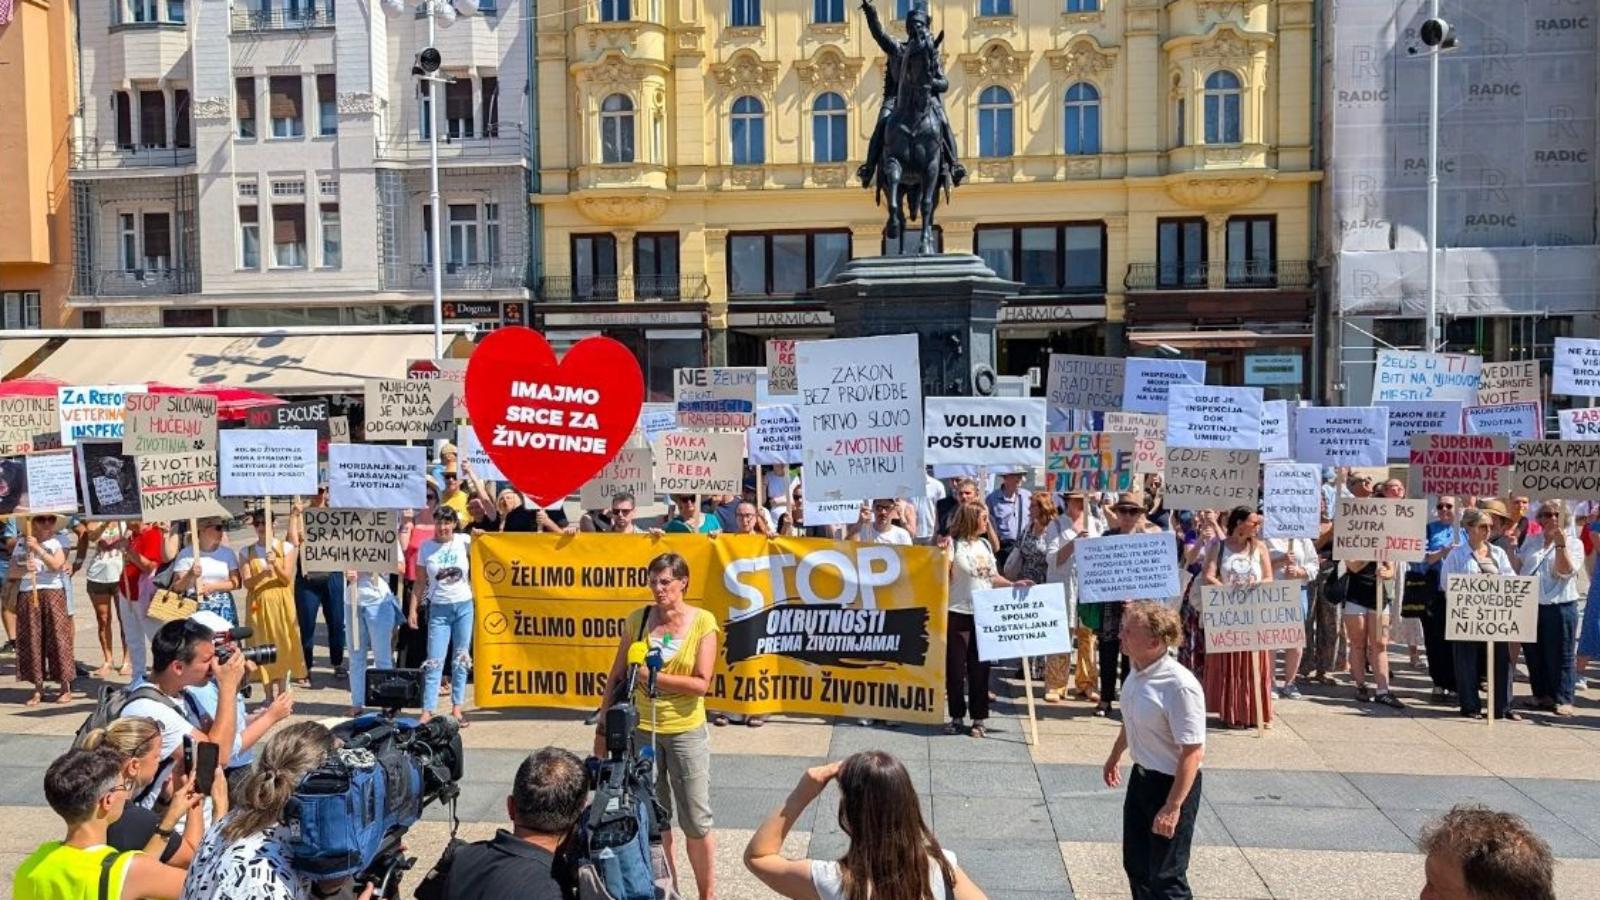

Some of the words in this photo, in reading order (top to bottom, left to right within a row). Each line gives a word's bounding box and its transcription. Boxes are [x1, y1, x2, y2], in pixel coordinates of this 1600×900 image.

[1535, 17, 1589, 31] RADIĆ
[1338, 89, 1389, 102] RADIĆ
[1469, 82, 1521, 96] RADIĆ
[1534, 149, 1588, 163] RADIĆ
[1404, 157, 1456, 173] RAIĆ
[1465, 213, 1516, 228] RADIĆ
[456, 303, 492, 316] Dogma
[1005, 306, 1074, 321] HARMICA
[757, 312, 822, 325] HARMICA
[1444, 356, 1467, 373] TI
[1481, 363, 1534, 379] VEDITE
[409, 370, 439, 379] STOP
[679, 370, 707, 387] NE
[832, 363, 894, 385] ZAKON
[1410, 372, 1426, 385] NA
[1060, 376, 1113, 393] RADITE
[62, 389, 84, 405] ZA
[511, 380, 600, 406] IMAJMO
[803, 387, 831, 405] BEZ
[838, 383, 908, 403] PROVEDBE
[0, 397, 55, 412] IVOTINJE
[126, 397, 160, 412] STOP
[380, 405, 392, 416] JE
[277, 403, 327, 424] EXCUSE
[506, 405, 564, 427] SRCE
[568, 411, 600, 430] ZA
[813, 411, 857, 432] MRTVO
[868, 408, 911, 429] SLOVO
[944, 414, 1016, 427] VOLIMO
[1020, 414, 1026, 427] I
[132, 418, 137, 432] I
[492, 425, 607, 455] ŽIVOTINJE
[665, 435, 706, 447] SVAKA
[927, 432, 1042, 449] POŠTUJEMO
[1430, 434, 1493, 449] SUDBINA
[666, 447, 718, 462] PRIJAVA
[1168, 448, 1209, 462] GDJE
[1227, 451, 1249, 466] SU
[1517, 442, 1563, 457] SVAKA
[1567, 443, 1600, 458] PRIJA
[667, 463, 712, 477] TREBA
[815, 461, 837, 477] NA
[849, 456, 904, 474] PAPIRU!
[1171, 467, 1244, 481] PROGRAMI
[1422, 465, 1482, 480] RUKAMA
[1483, 467, 1499, 481] JE
[1515, 459, 1560, 474] MORA
[141, 476, 159, 489] NE
[161, 471, 193, 484] MOŽE
[660, 477, 739, 492] POSTUPANJE!
[1422, 480, 1500, 497] INSPEKCIJE
[1341, 504, 1388, 517] DANAS
[1395, 503, 1415, 517] PAS
[305, 511, 363, 526] DOSTA
[368, 511, 387, 526] JE
[1347, 520, 1385, 532] SUTRA
[306, 528, 396, 544] SRAMOTNO
[1337, 534, 1379, 548] NEČIJE
[305, 546, 350, 561] BLAGIH
[352, 547, 391, 562] KAZNI
[510, 560, 575, 588] ŽELIMO
[581, 566, 649, 588] KONTRO
[724, 546, 902, 621] STOP
[1450, 578, 1500, 593] ZAKON
[1503, 579, 1532, 594] BEZ
[1209, 586, 1293, 607] ŽIVOTINJE
[1456, 594, 1525, 608] PROVEDBE
[992, 602, 1029, 613] ZATVOR
[1031, 601, 1045, 610] ZA
[1451, 607, 1469, 619] NE
[1475, 605, 1512, 620] ŠTITI
[514, 610, 575, 638] ŽELIMO
[582, 618, 626, 638] ODGO
[766, 608, 887, 635] OKRUTNOSTI
[1001, 611, 1040, 622] SPOLNO
[982, 619, 1059, 634] ZLOSTAVLJANJE
[1456, 621, 1520, 635] NIKOGA
[756, 635, 802, 655] PREMA
[1210, 629, 1251, 647] VAŠEG
[1256, 628, 1305, 645] NERADA
[491, 664, 568, 695] ŽELIMO
[575, 671, 608, 696] INS
[733, 669, 813, 702] ZAŠTITU
[820, 671, 935, 713] ŽIVOTINJA!
